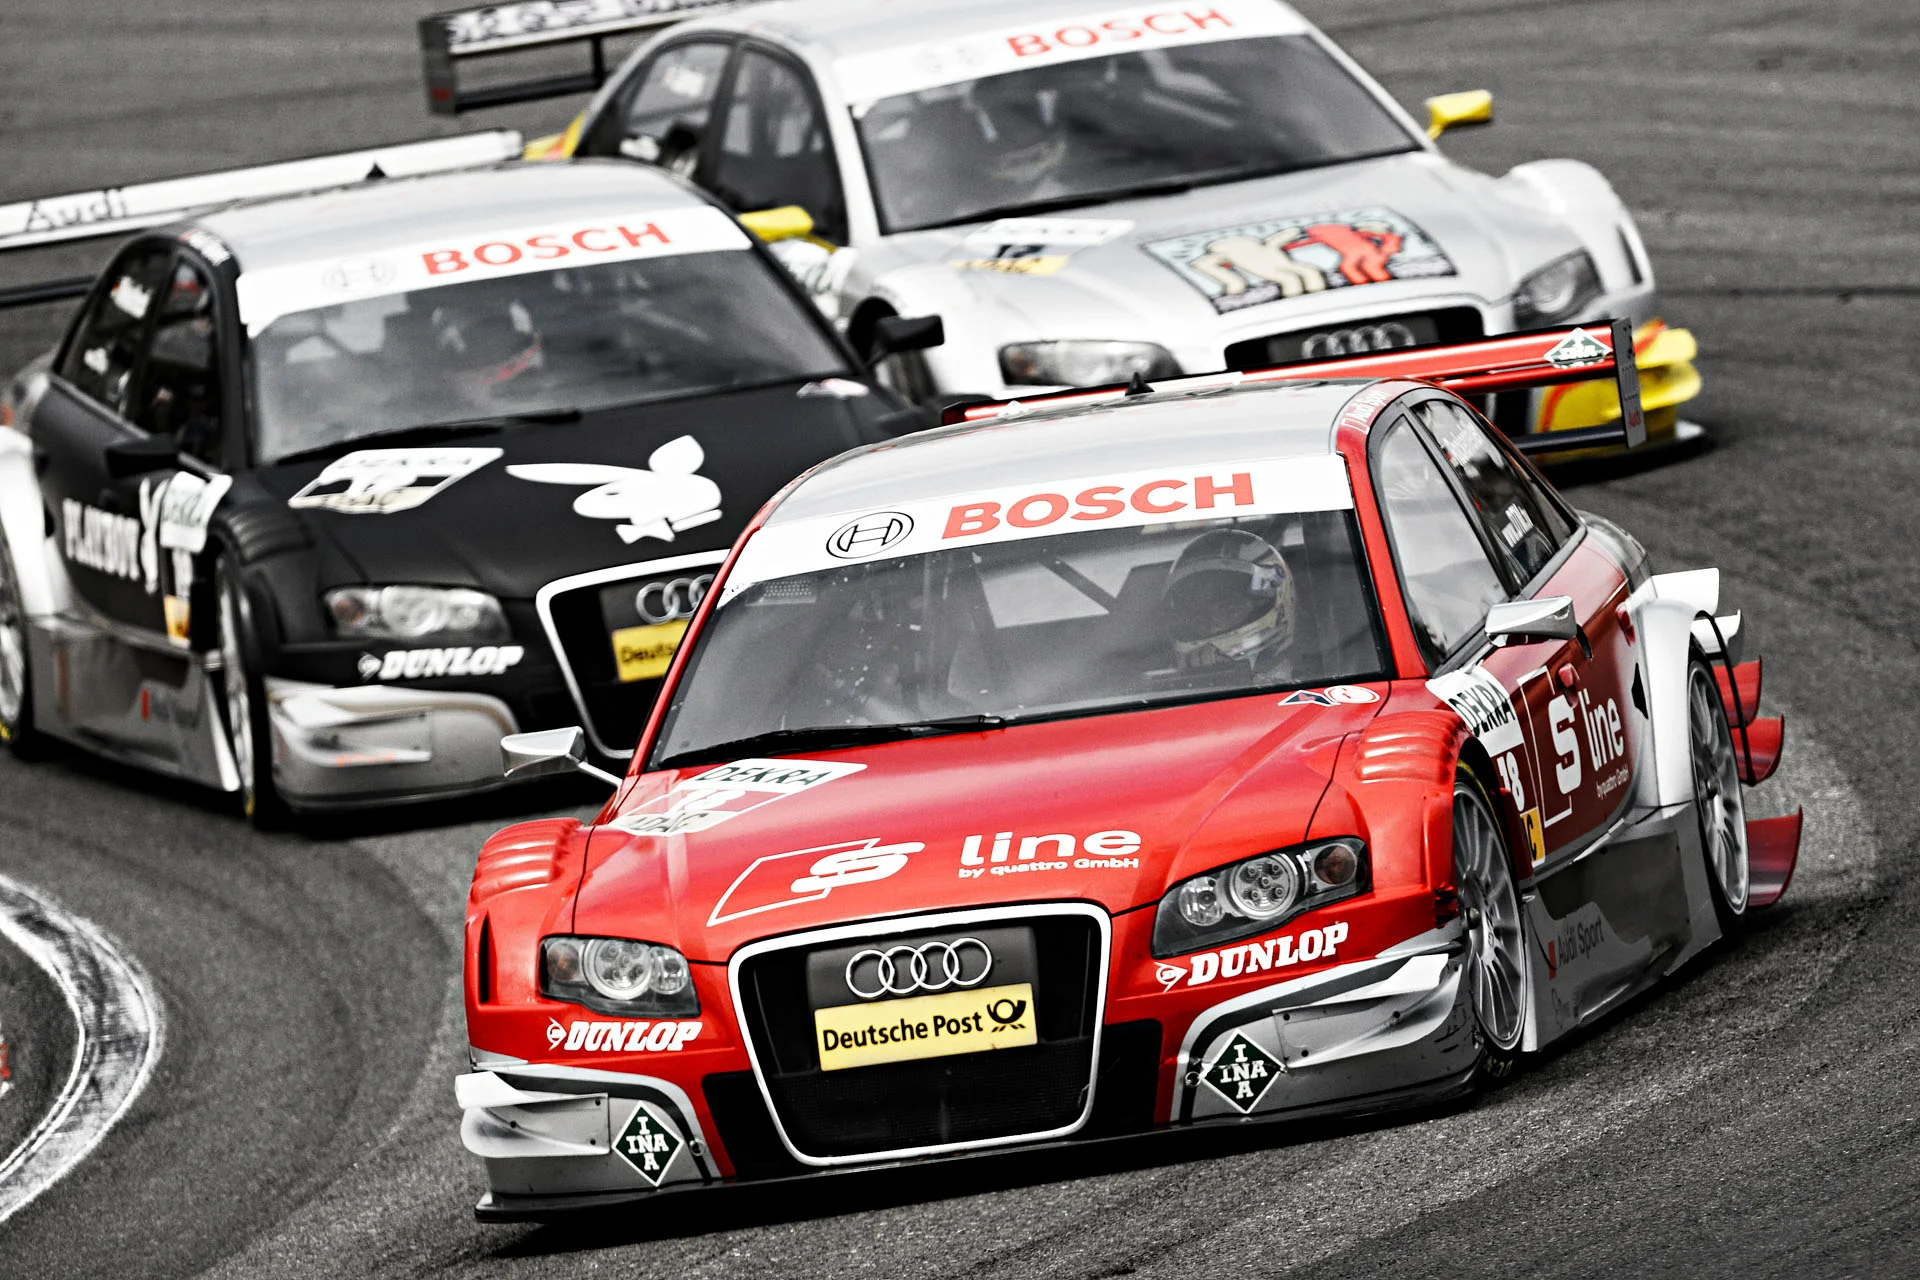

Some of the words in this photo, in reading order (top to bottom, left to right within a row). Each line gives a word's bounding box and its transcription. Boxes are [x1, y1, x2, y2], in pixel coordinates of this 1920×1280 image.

[1006, 7, 1232, 57] BOSCH
[24, 187, 128, 233] Audi
[421, 222, 671, 275] BOSCH
[941, 472, 1255, 540] BOSCH
[378, 646, 525, 680] DUNLOP
[1548, 694, 1582, 795] S
[1578, 687, 1624, 771] line
[694, 766, 833, 787] DEKRA
[790, 841, 926, 893] S
[959, 829, 1142, 867] line
[957, 867, 985, 879] by
[990, 860, 1069, 877] quattro
[1073, 857, 1139, 869] GmbH
[1187, 921, 1349, 987] DUNLOP
[1577, 919, 1604, 961] Sport
[563, 1021, 703, 1052] DUNLOP
[822, 1018, 928, 1052] Deutsche
[932, 1012, 984, 1038] Post
[1218, 1060, 1268, 1084] INA
[625, 1133, 670, 1155] INA
